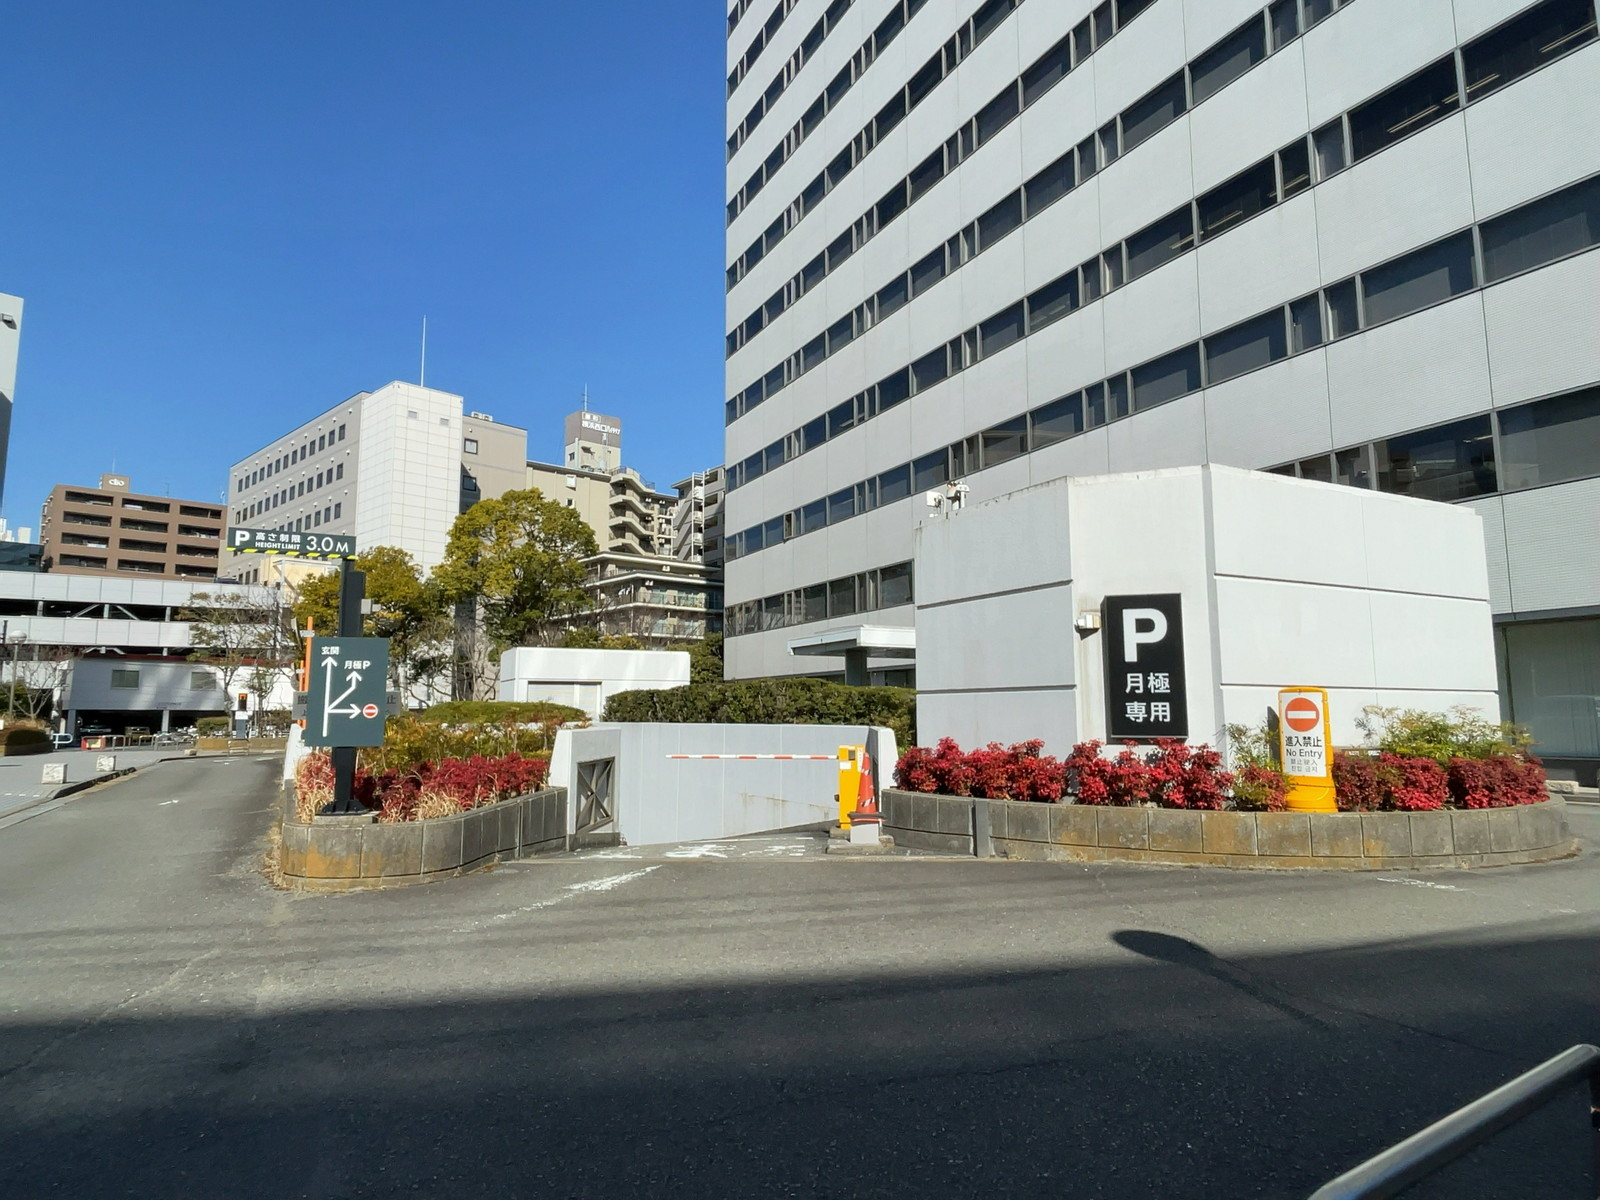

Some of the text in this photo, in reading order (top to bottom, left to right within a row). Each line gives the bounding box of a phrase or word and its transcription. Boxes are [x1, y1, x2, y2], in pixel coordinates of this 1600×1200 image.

[235, 530, 250, 546] P
[255, 532, 301, 543] 高さ制限
[255, 541, 281, 549] HEIGHT
[1122, 607, 1168, 663] P
[321, 646, 340, 655] 玄関
[1125, 672, 1171, 694] 月極
[1125, 701, 1171, 723] 専用
[1285, 736, 1323, 748] 進入禁止
[1286, 748, 1323, 760] No Entry
